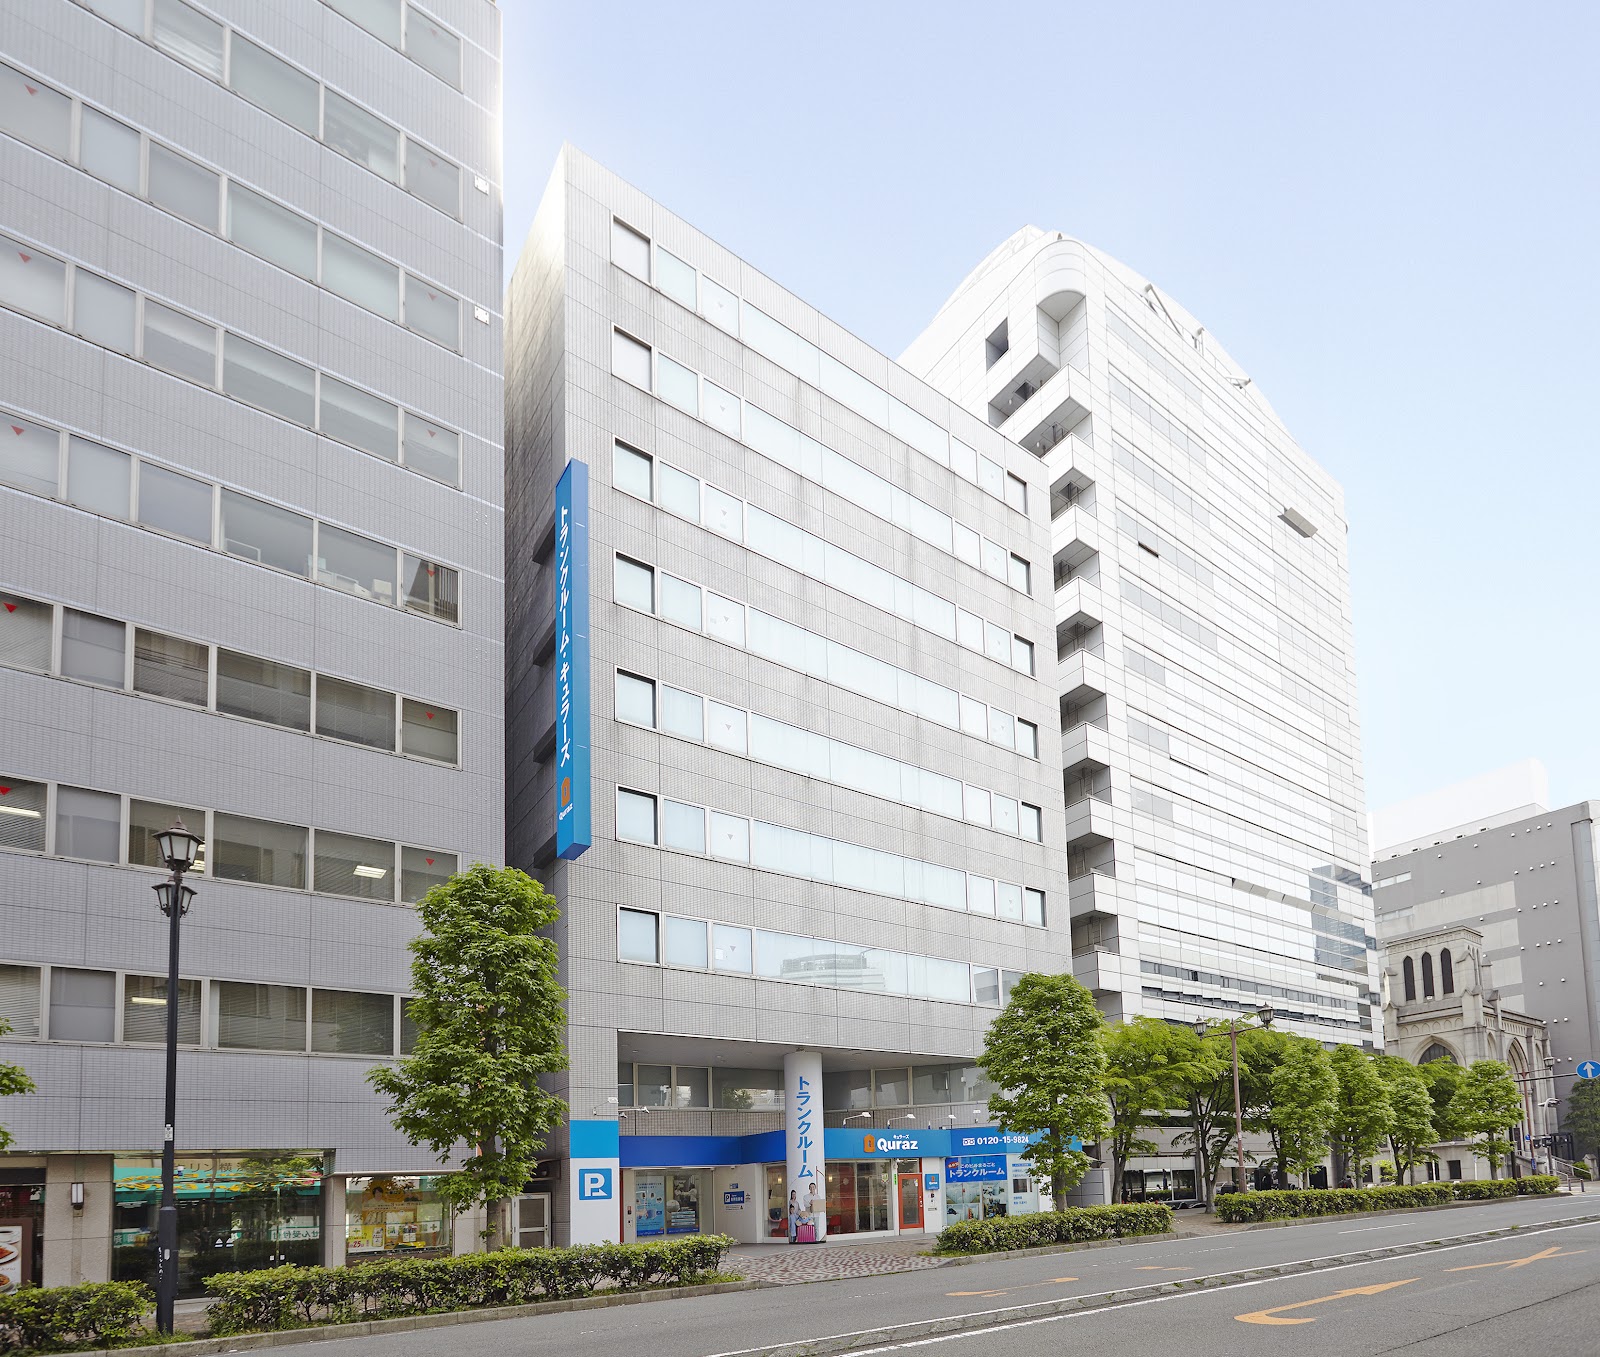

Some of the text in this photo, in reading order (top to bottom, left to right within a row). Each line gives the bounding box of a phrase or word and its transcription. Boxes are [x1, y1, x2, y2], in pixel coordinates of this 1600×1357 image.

[559, 505, 570, 768] トランクルーム・キュラーズ
[796, 1076, 813, 1179] トランクルーム
[877, 1138, 919, 1152] Quraz
[977, 1136, 1029, 1145] 0120-15-9824
[949, 1167, 1005, 1178] トランクルーム
